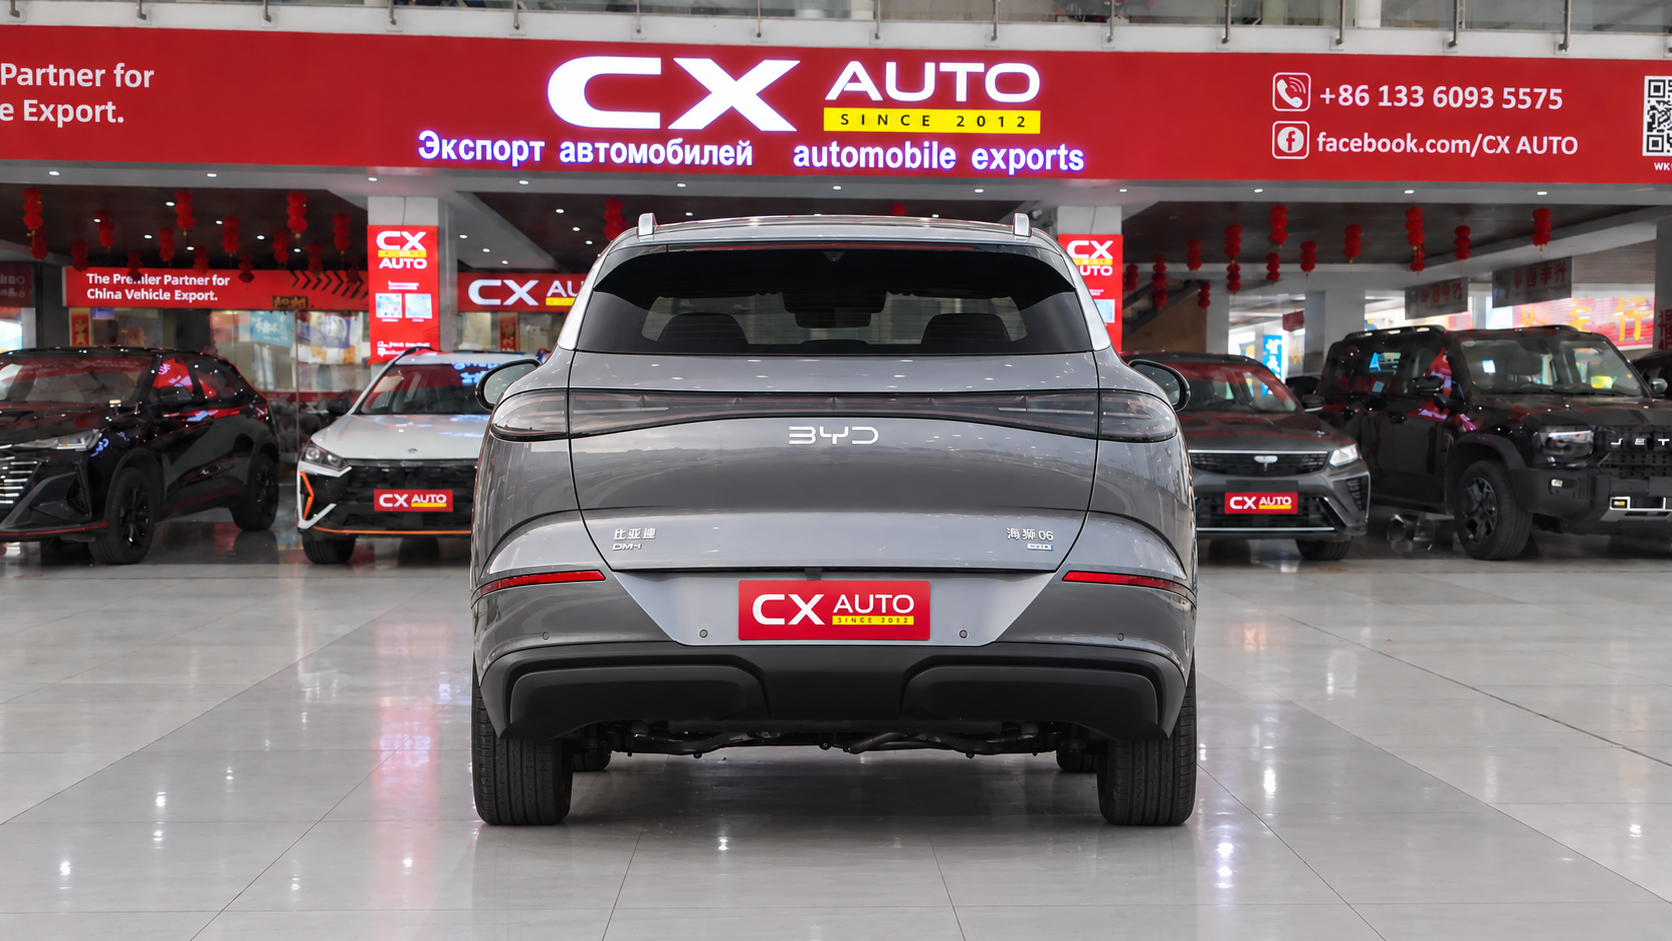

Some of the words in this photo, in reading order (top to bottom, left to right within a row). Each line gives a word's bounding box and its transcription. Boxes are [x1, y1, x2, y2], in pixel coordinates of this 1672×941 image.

[1, 63, 106, 87] Partner
[114, 63, 155, 87] for
[825, 61, 1041, 103] AUTO
[548, 56, 800, 131] CX
[1320, 85, 1370, 107] +86
[1378, 85, 1424, 108] 133
[1433, 86, 1494, 109] 6093
[1502, 87, 1563, 110] 5575
[24, 99, 125, 128] Export.
[840, 113, 931, 127] SINCE
[956, 115, 1027, 128] 2012
[418, 129, 545, 167] Экспорт
[560, 138, 753, 166] автомобилей
[1317, 132, 1510, 157] facebook.com/CX
[1516, 136, 1579, 155] AUTO
[793, 141, 957, 170] automobile
[972, 143, 1085, 175] exports
[1654, 162, 1672, 171] WK
[376, 230, 427, 251] CX
[1067, 240, 1114, 259] CX
[379, 258, 428, 269] AUTO
[1080, 265, 1113, 276] UTO
[86, 273, 110, 285] The
[164, 274, 210, 286] Partner
[212, 274, 231, 286] for
[87, 288, 122, 300] China
[125, 288, 171, 301] Vehicle
[174, 289, 218, 303] Export.
[468, 279, 539, 306] CX
[546, 280, 584, 298] AU
[789, 426, 879, 445] BYD
[379, 493, 409, 508] CX
[411, 493, 447, 504] AUTO
[1230, 496, 1257, 510] CX
[1259, 496, 1292, 506] AUTO
[613, 527, 656, 540] 比亚迪
[753, 593, 825, 626] CX
[833, 593, 915, 614] AUTO
